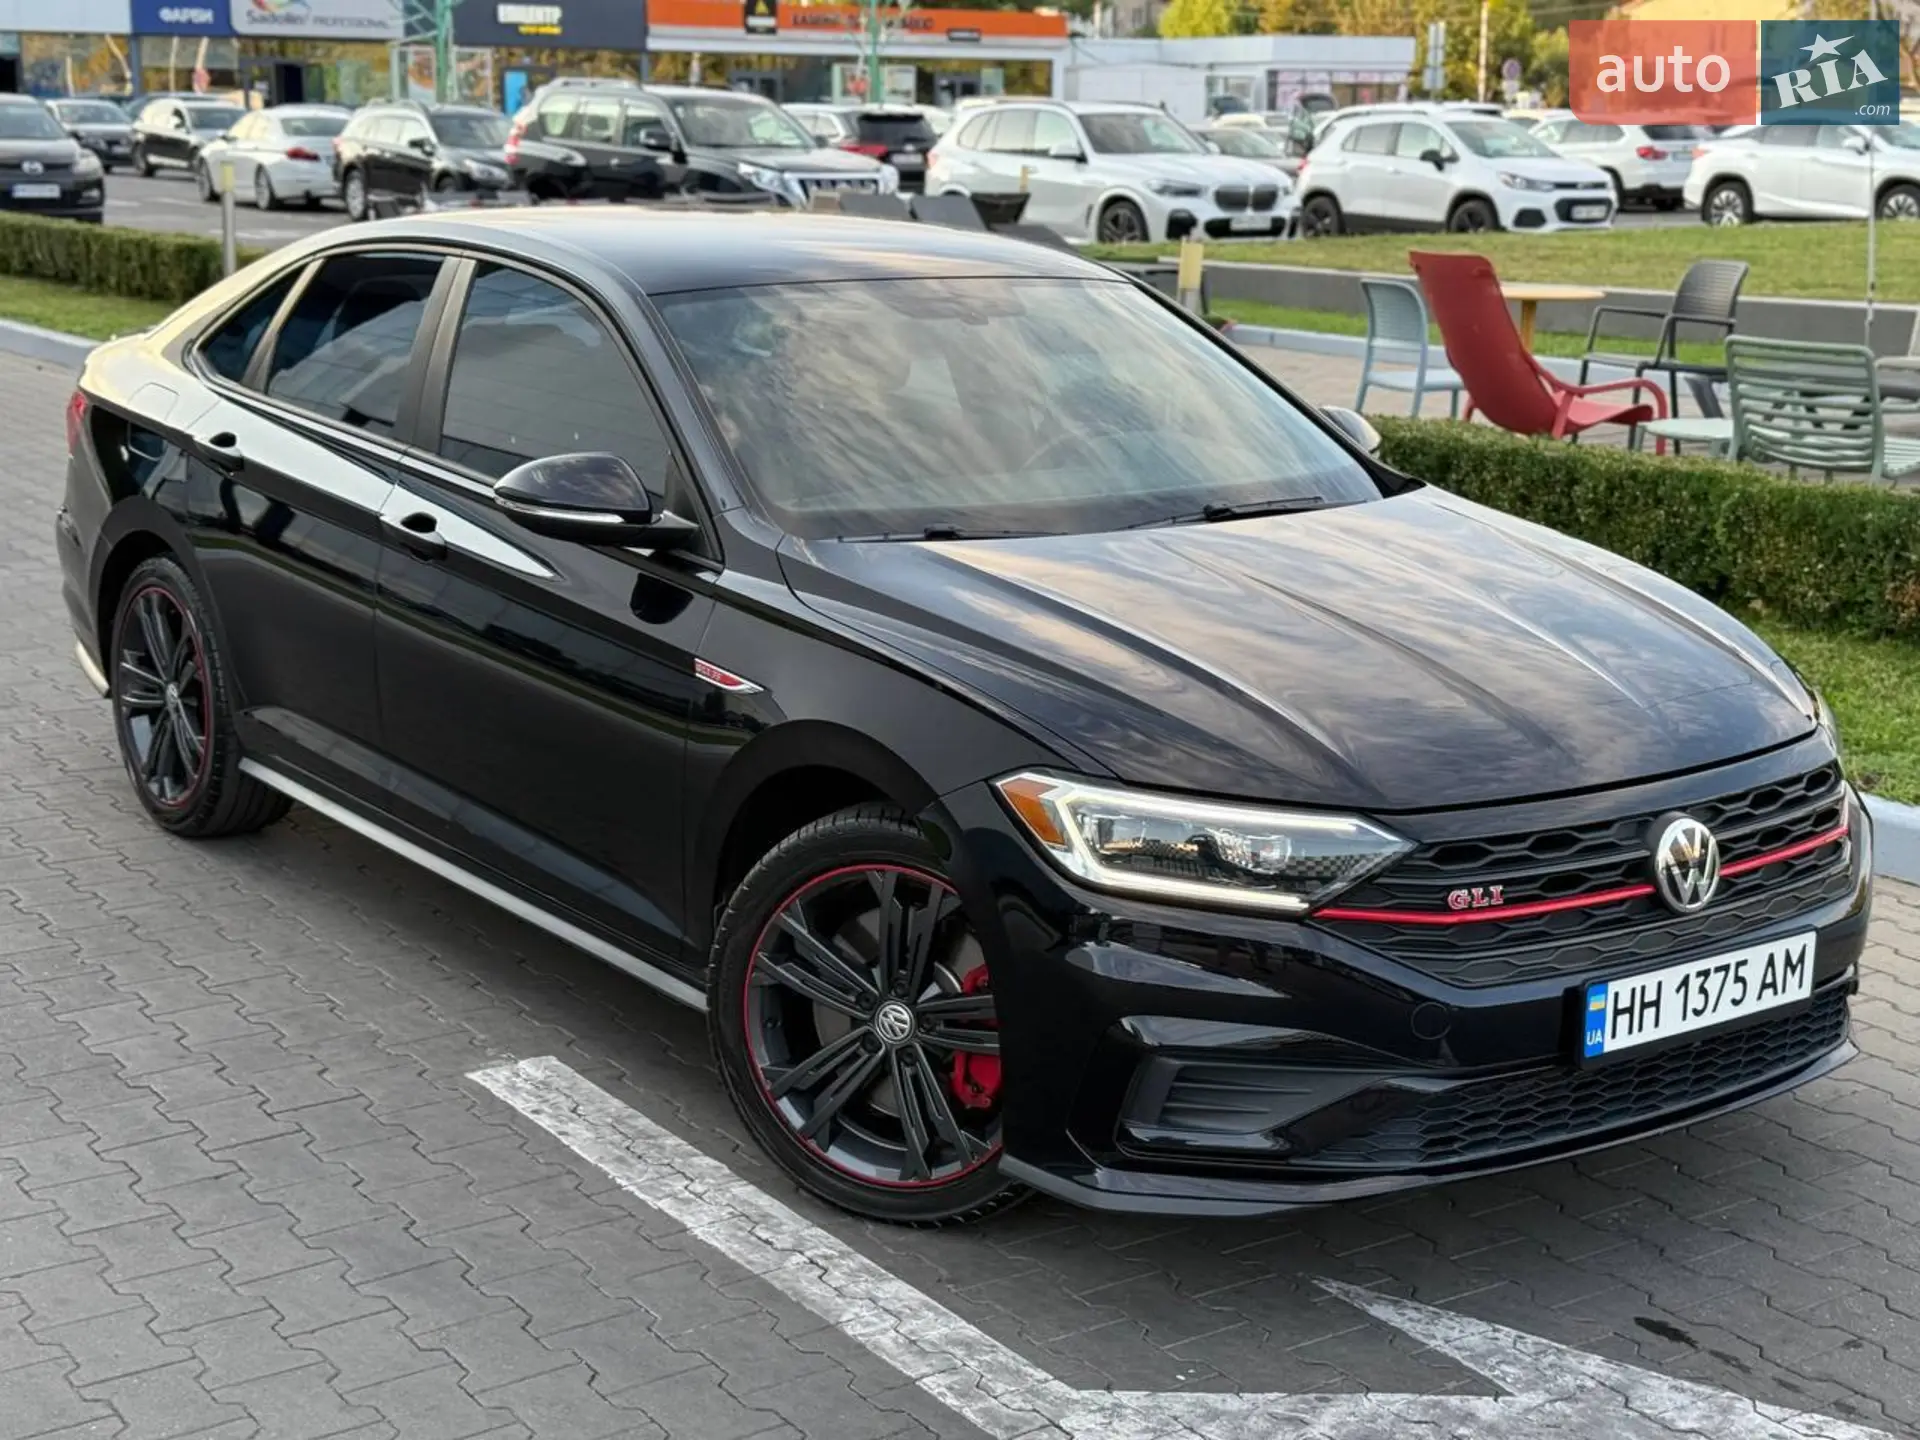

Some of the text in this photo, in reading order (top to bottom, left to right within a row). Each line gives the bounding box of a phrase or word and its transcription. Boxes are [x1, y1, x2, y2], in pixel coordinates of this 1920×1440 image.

[1447, 884, 1505, 910] GLI
[1610, 943, 1807, 1040] HH 1375 AM
[1586, 1029, 1603, 1046] UA
